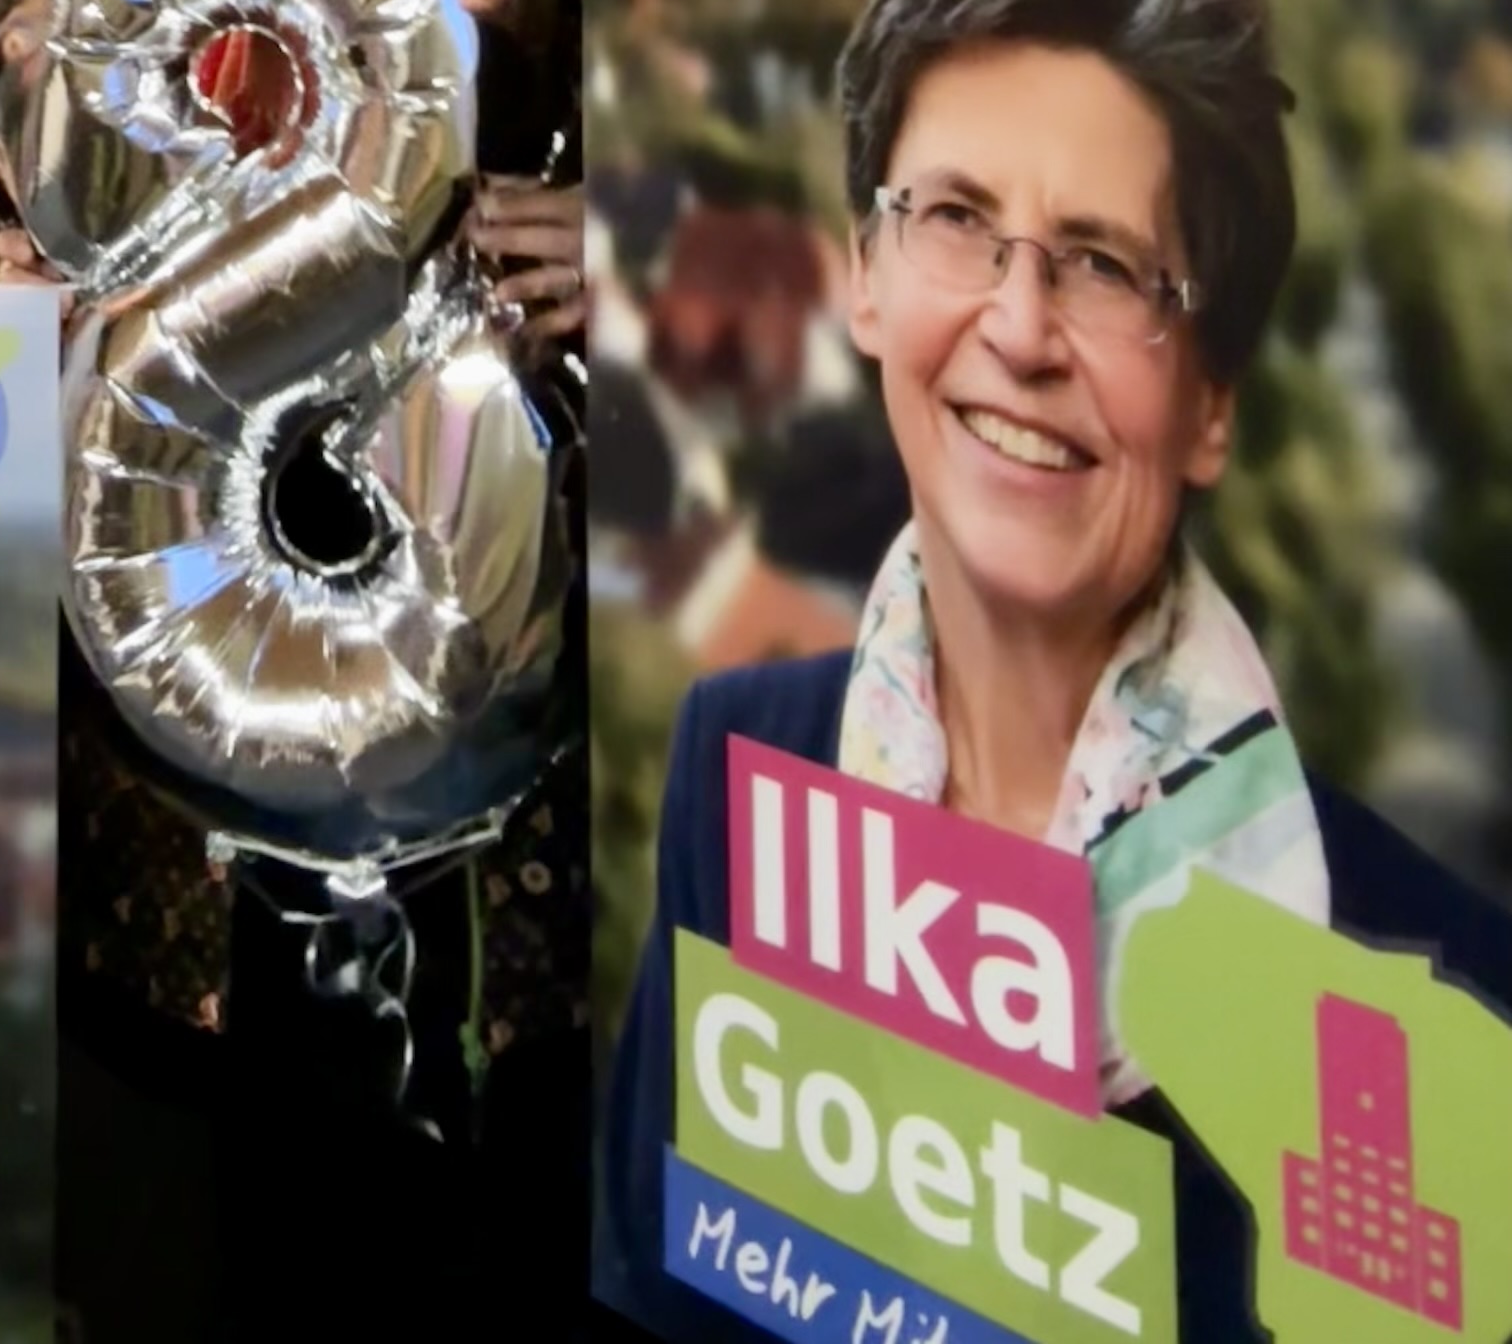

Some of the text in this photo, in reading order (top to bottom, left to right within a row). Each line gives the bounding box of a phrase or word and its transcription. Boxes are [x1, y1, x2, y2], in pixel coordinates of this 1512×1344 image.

[751, 774, 1076, 1072] Ilka
[688, 1202, 836, 1320] Mehr
[693, 992, 1143, 1338] Goetz
